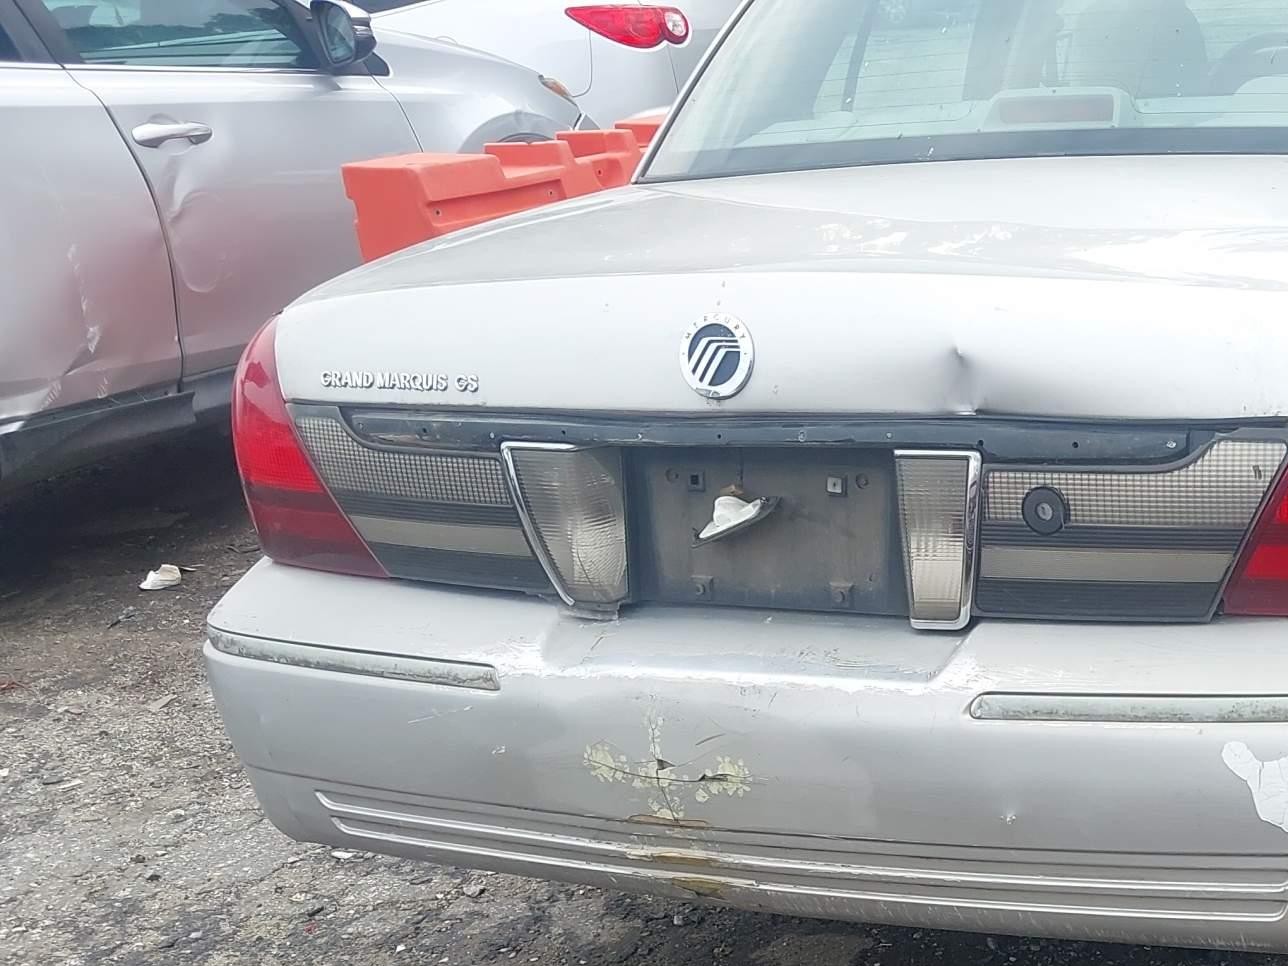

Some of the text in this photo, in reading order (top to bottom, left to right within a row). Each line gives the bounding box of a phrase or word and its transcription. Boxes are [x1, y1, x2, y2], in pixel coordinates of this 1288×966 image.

[320, 370, 480, 393] GRAND MARQUIS GS
